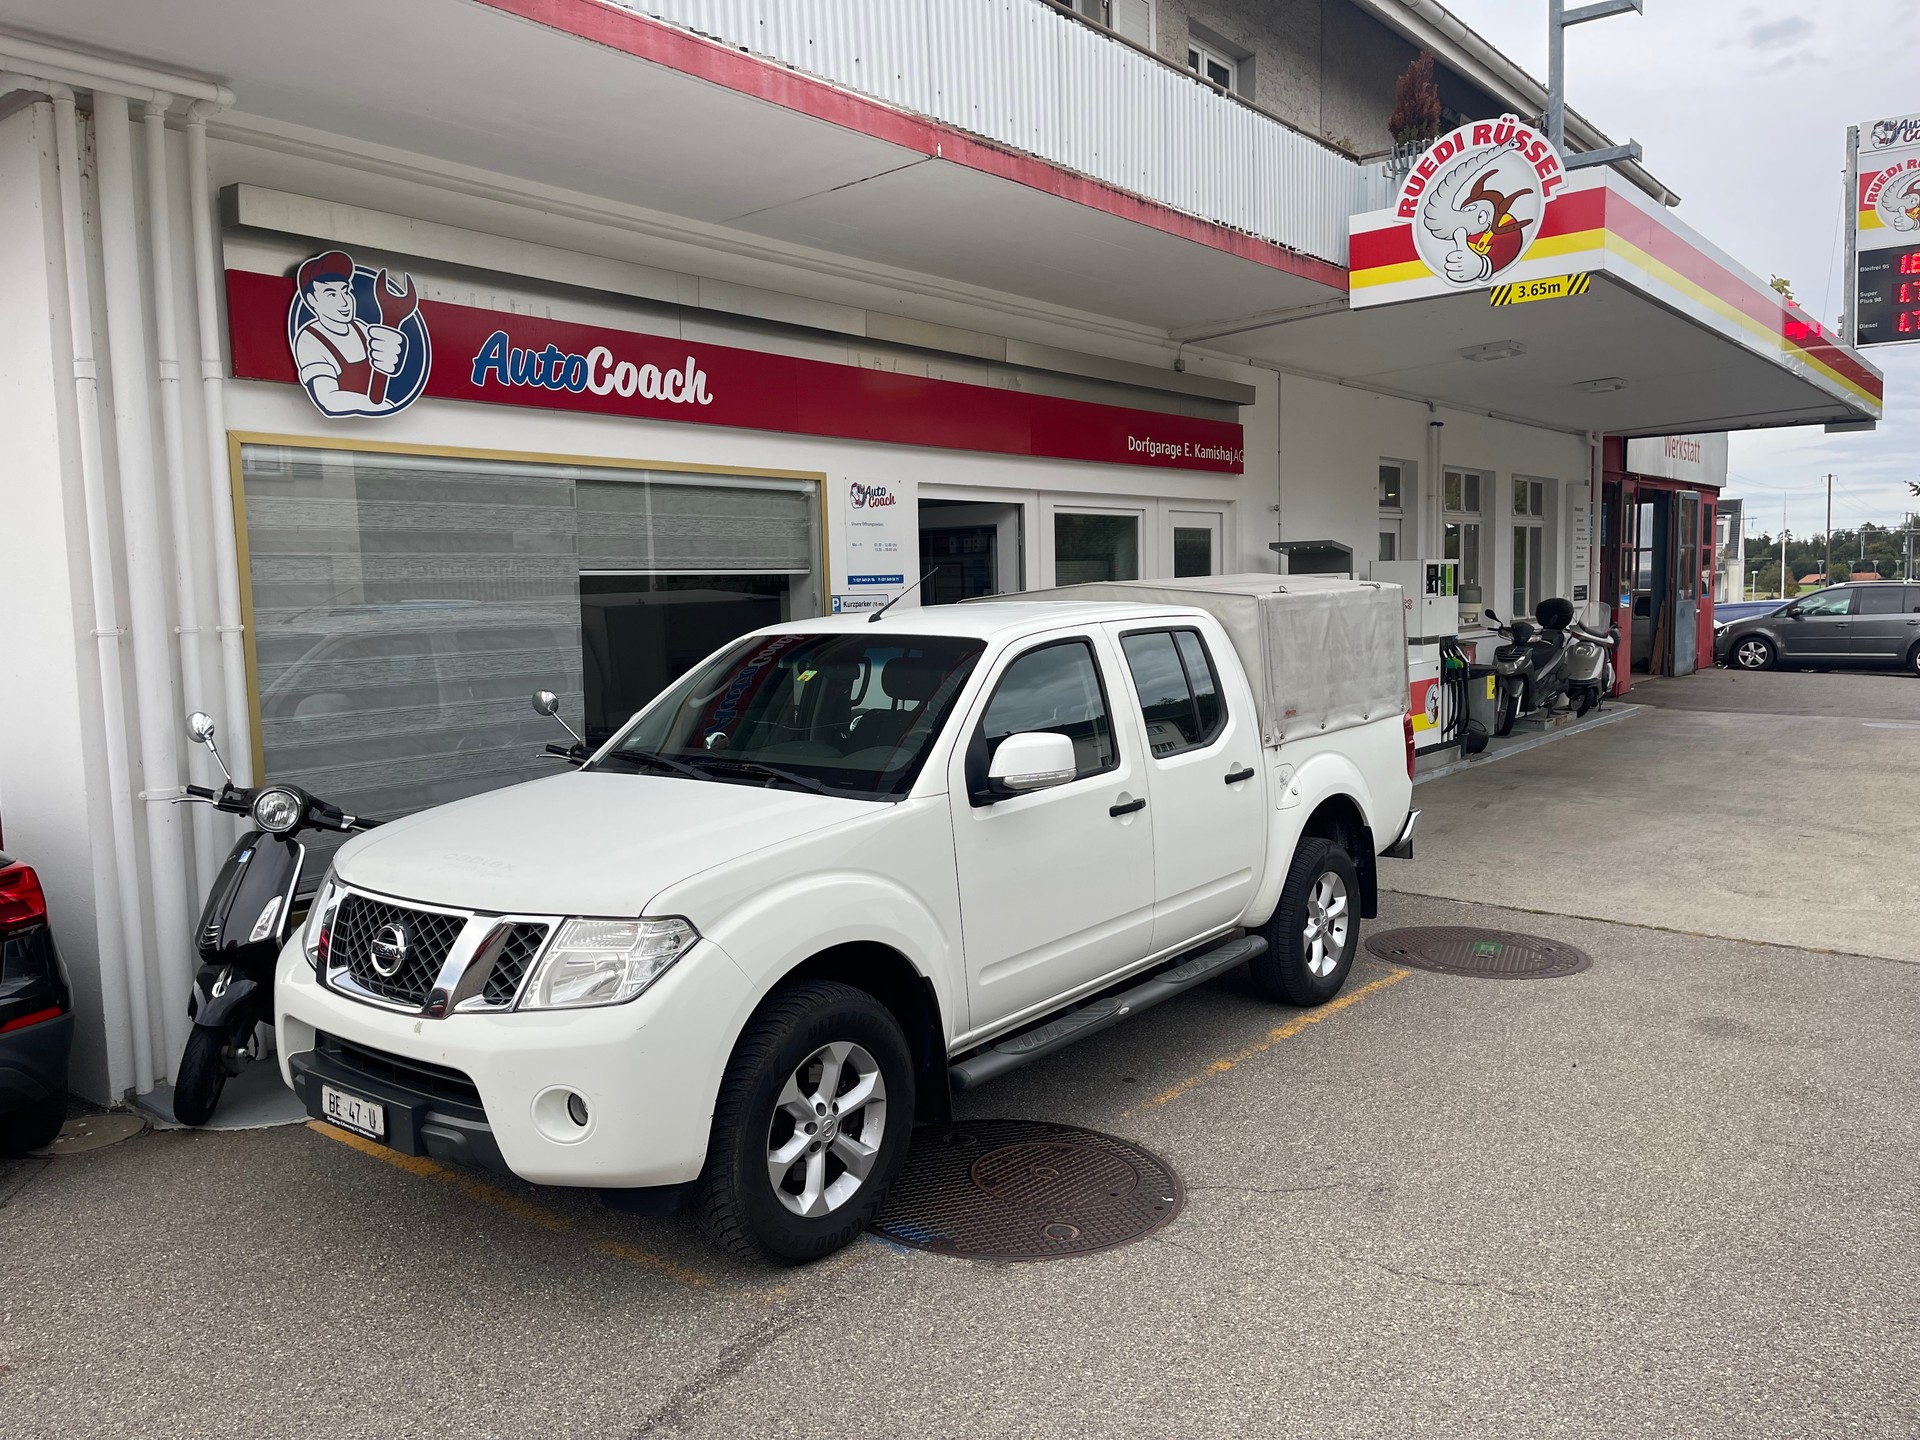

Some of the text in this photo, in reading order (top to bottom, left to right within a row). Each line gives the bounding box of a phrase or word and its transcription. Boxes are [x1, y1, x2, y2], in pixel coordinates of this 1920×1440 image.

[1897, 119, 1920, 134] Au
[1398, 117, 1563, 218] RUEDI RÜSSEL
[1867, 159, 1920, 202] RUEDI R
[1517, 282, 1561, 299] 3.65m
[1127, 435, 1182, 460] Dorfgarage
[1184, 442, 1192, 457] E.
[1194, 443, 1233, 465] Kamishaj
[1664, 435, 1700, 464] Werkstatt
[864, 485, 886, 499] Auto
[868, 492, 897, 508] Coach
[843, 601, 872, 609] Kurzparker
